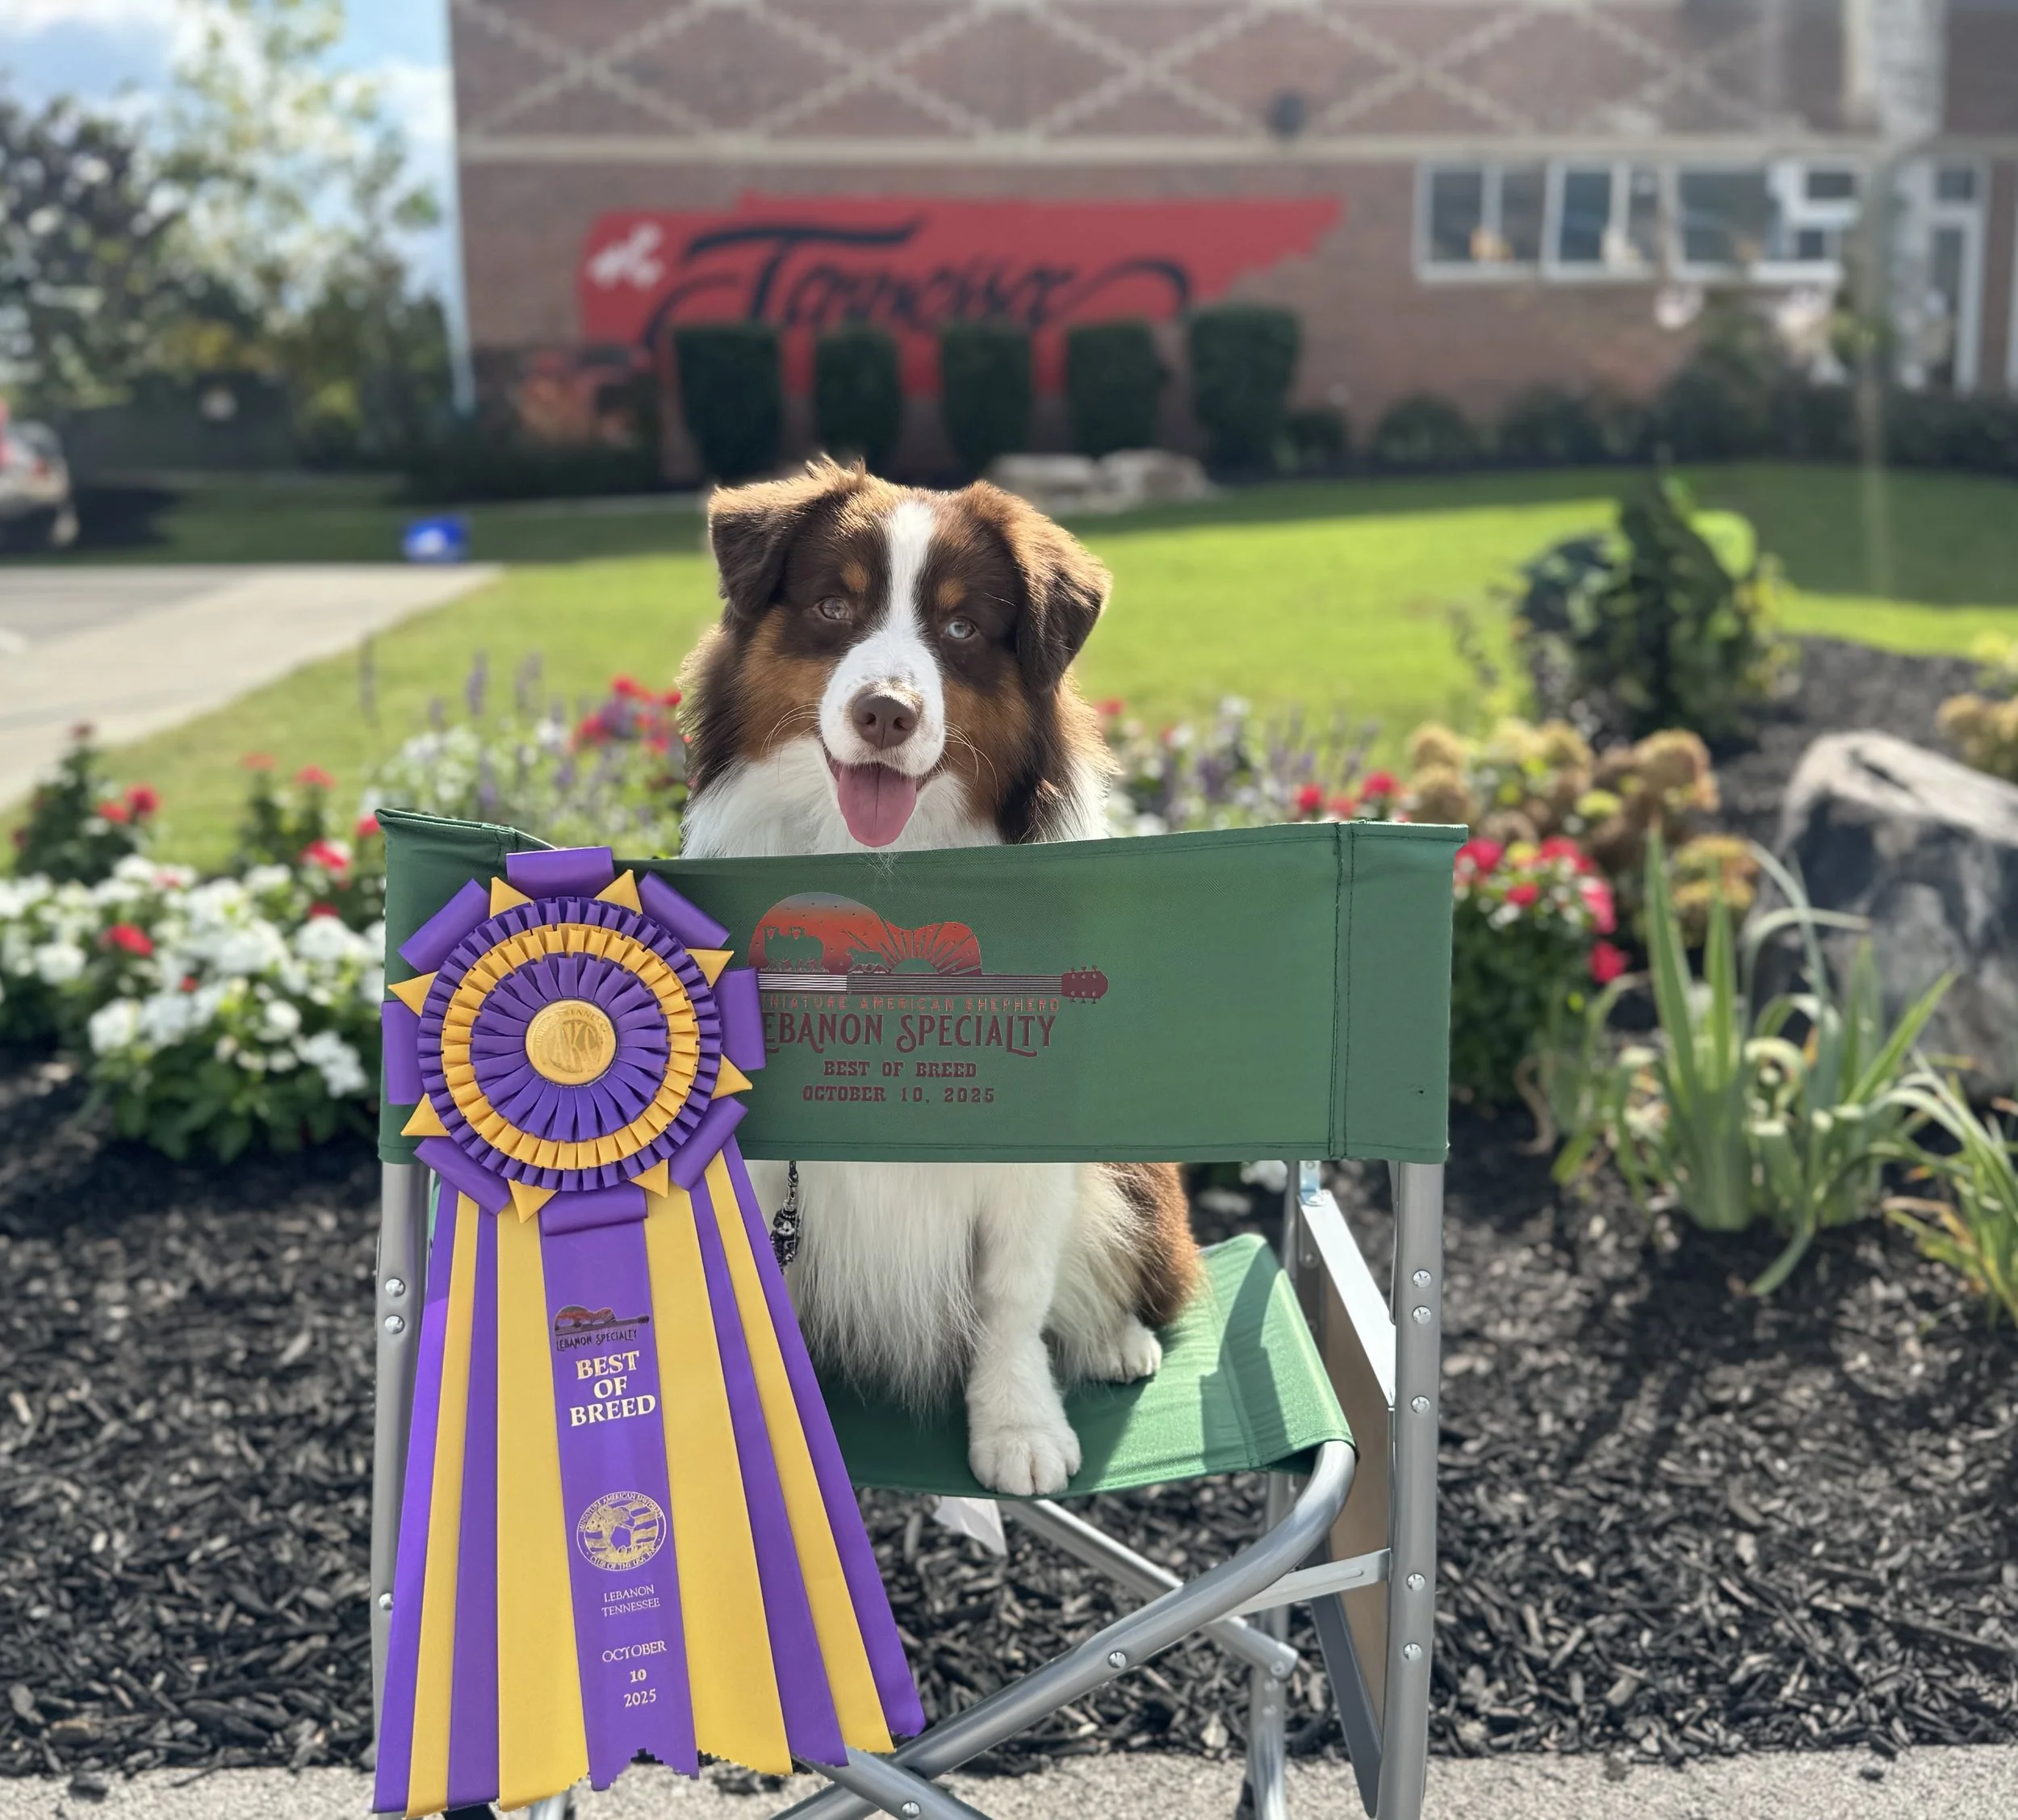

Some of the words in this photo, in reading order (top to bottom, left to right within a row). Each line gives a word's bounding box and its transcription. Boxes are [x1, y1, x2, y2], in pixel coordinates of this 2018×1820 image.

[762, 995, 847, 1010] INIATURE
[860, 997, 954, 1010] AMERICAN
[965, 998, 1059, 1012] SHEPHERD
[762, 1011, 883, 1054] EBANON
[896, 1014, 1057, 1057] SPECIALTY
[823, 1060, 870, 1077] BEST
[882, 1061, 904, 1077] OF
[915, 1062, 978, 1077] BREED
[802, 1086, 886, 1102] OCTOBER
[901, 1087, 930, 1104] 10,
[944, 1087, 994, 1102] 2025
[556, 1335, 592, 1352] LEBANON
[596, 1328, 637, 1345] SPECIALTY
[576, 1350, 640, 1379] BEST
[593, 1376, 627, 1399] OF
[570, 1395, 656, 1427] BREED
[604, 1584, 655, 1603] LEBANON
[601, 1597, 660, 1617] TENNESSEE
[602, 1640, 667, 1663] OCTOBER
[630, 1668, 647, 1683] 10
[624, 1688, 656, 1708] 2025
